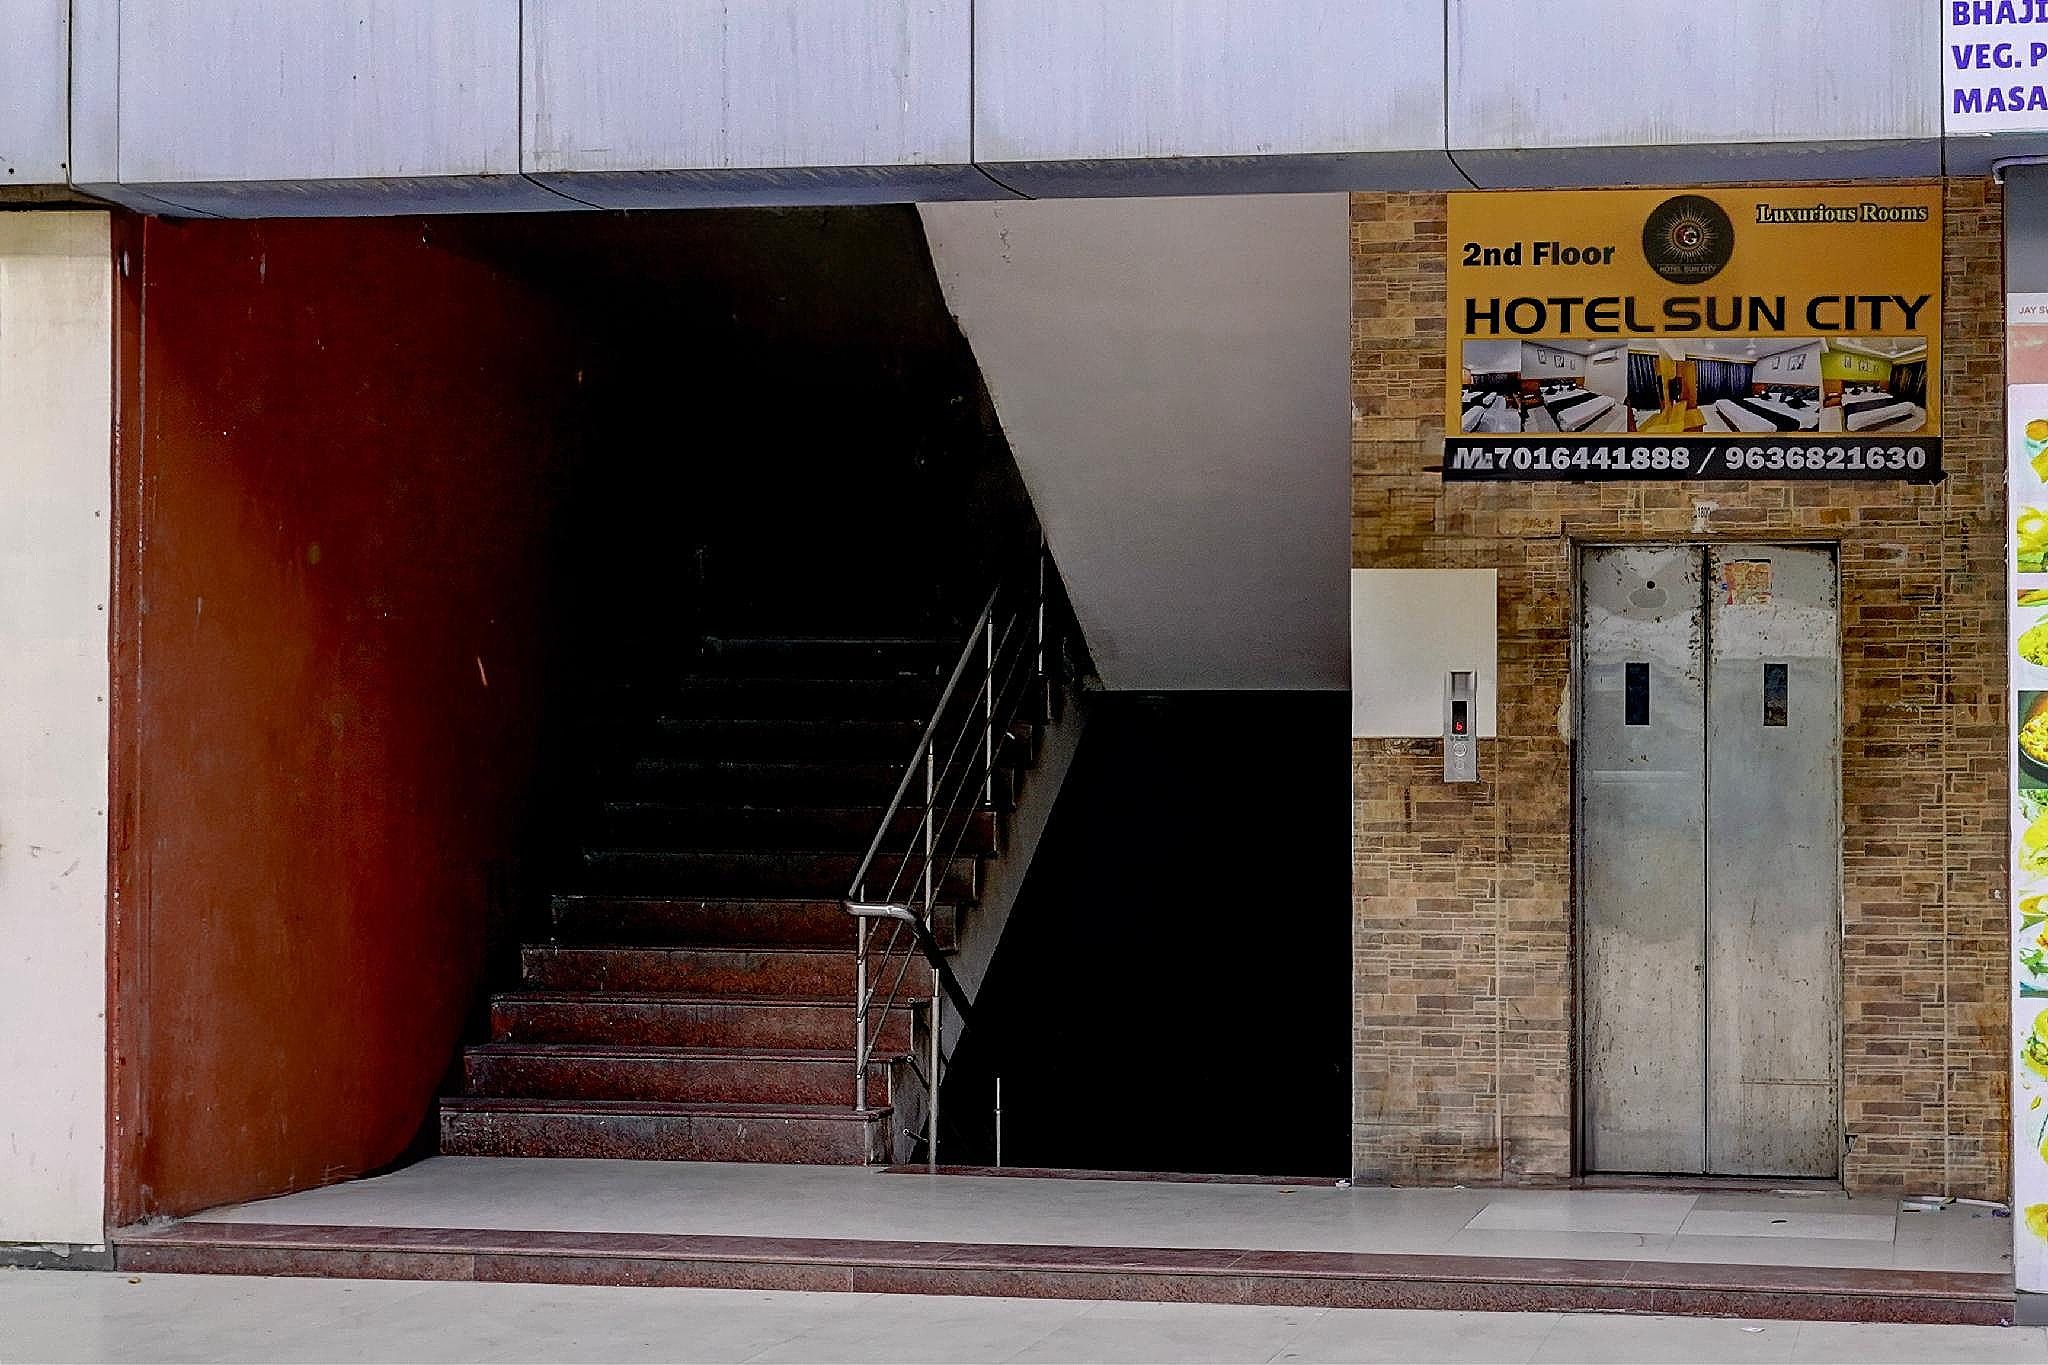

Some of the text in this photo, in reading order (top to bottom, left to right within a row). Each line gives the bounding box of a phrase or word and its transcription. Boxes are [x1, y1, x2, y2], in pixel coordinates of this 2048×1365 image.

[1952, 0, 2048, 25] BHAJI
[1951, 43, 2022, 70] VEG.
[1953, 85, 2048, 114] MASA
[1756, 203, 1928, 223] Luxurious Rooms
[1462, 241, 1616, 266] 2nd Floor
[1464, 295, 1932, 335] HOTEL SUN CITY
[1725, 446, 1926, 470] 9636821630
